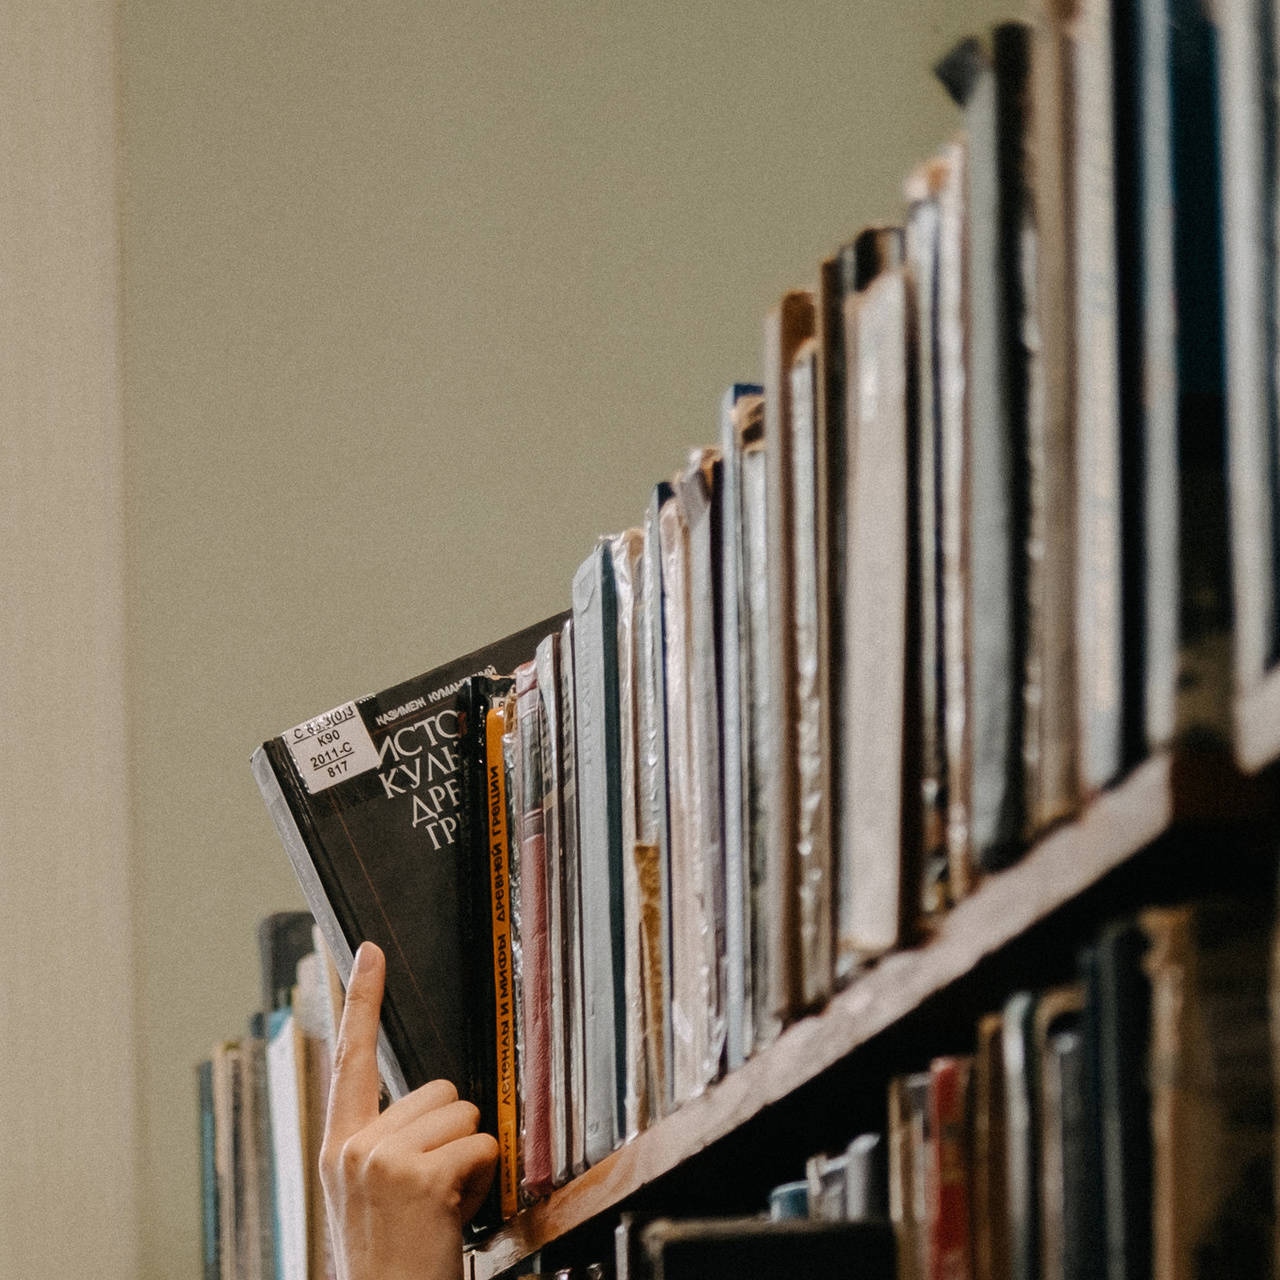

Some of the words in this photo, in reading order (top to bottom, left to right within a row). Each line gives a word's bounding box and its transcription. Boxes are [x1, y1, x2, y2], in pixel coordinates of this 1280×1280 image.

[427, 665, 498, 703] КУМАНИЙ
[327, 761, 350, 778] 817
[425, 812, 463, 851] ГР
[499, 1001, 510, 1016] И
